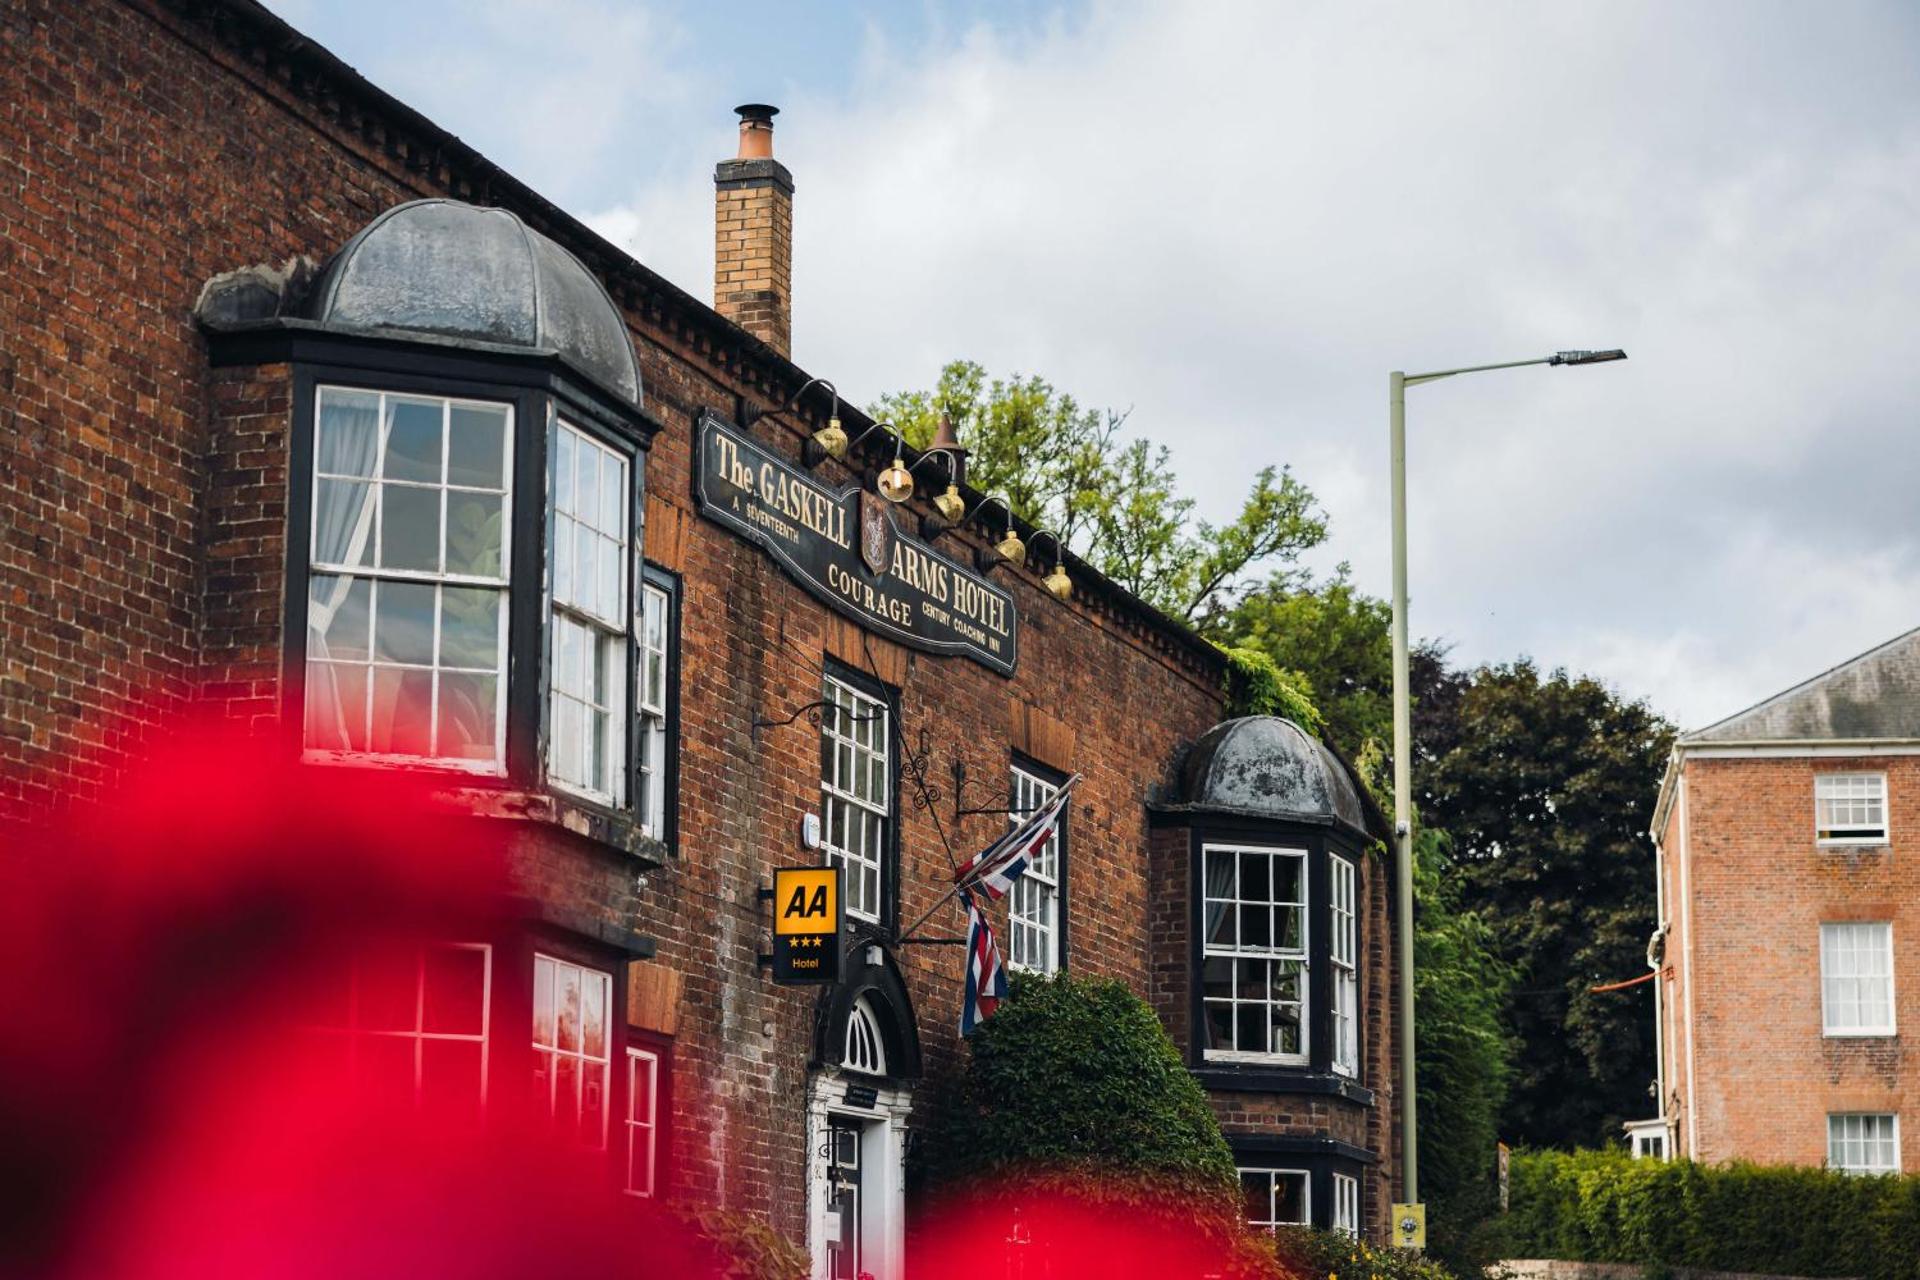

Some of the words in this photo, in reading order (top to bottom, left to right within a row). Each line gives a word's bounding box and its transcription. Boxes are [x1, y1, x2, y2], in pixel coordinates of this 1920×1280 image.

[716, 433, 753, 493] The
[760, 462, 851, 550] GASKELL
[890, 541, 947, 603] ARMS
[953, 573, 1009, 637] HOTEL
[732, 496, 740, 510] A
[746, 502, 800, 544] SEVENTEENTH
[922, 602, 950, 627] CENTURY
[953, 619, 986, 645] COACHING
[988, 637, 1000, 653] INN
[827, 564, 912, 627] COURAGE
[784, 885, 827, 918] AA
[792, 958, 819, 969] Hotel
